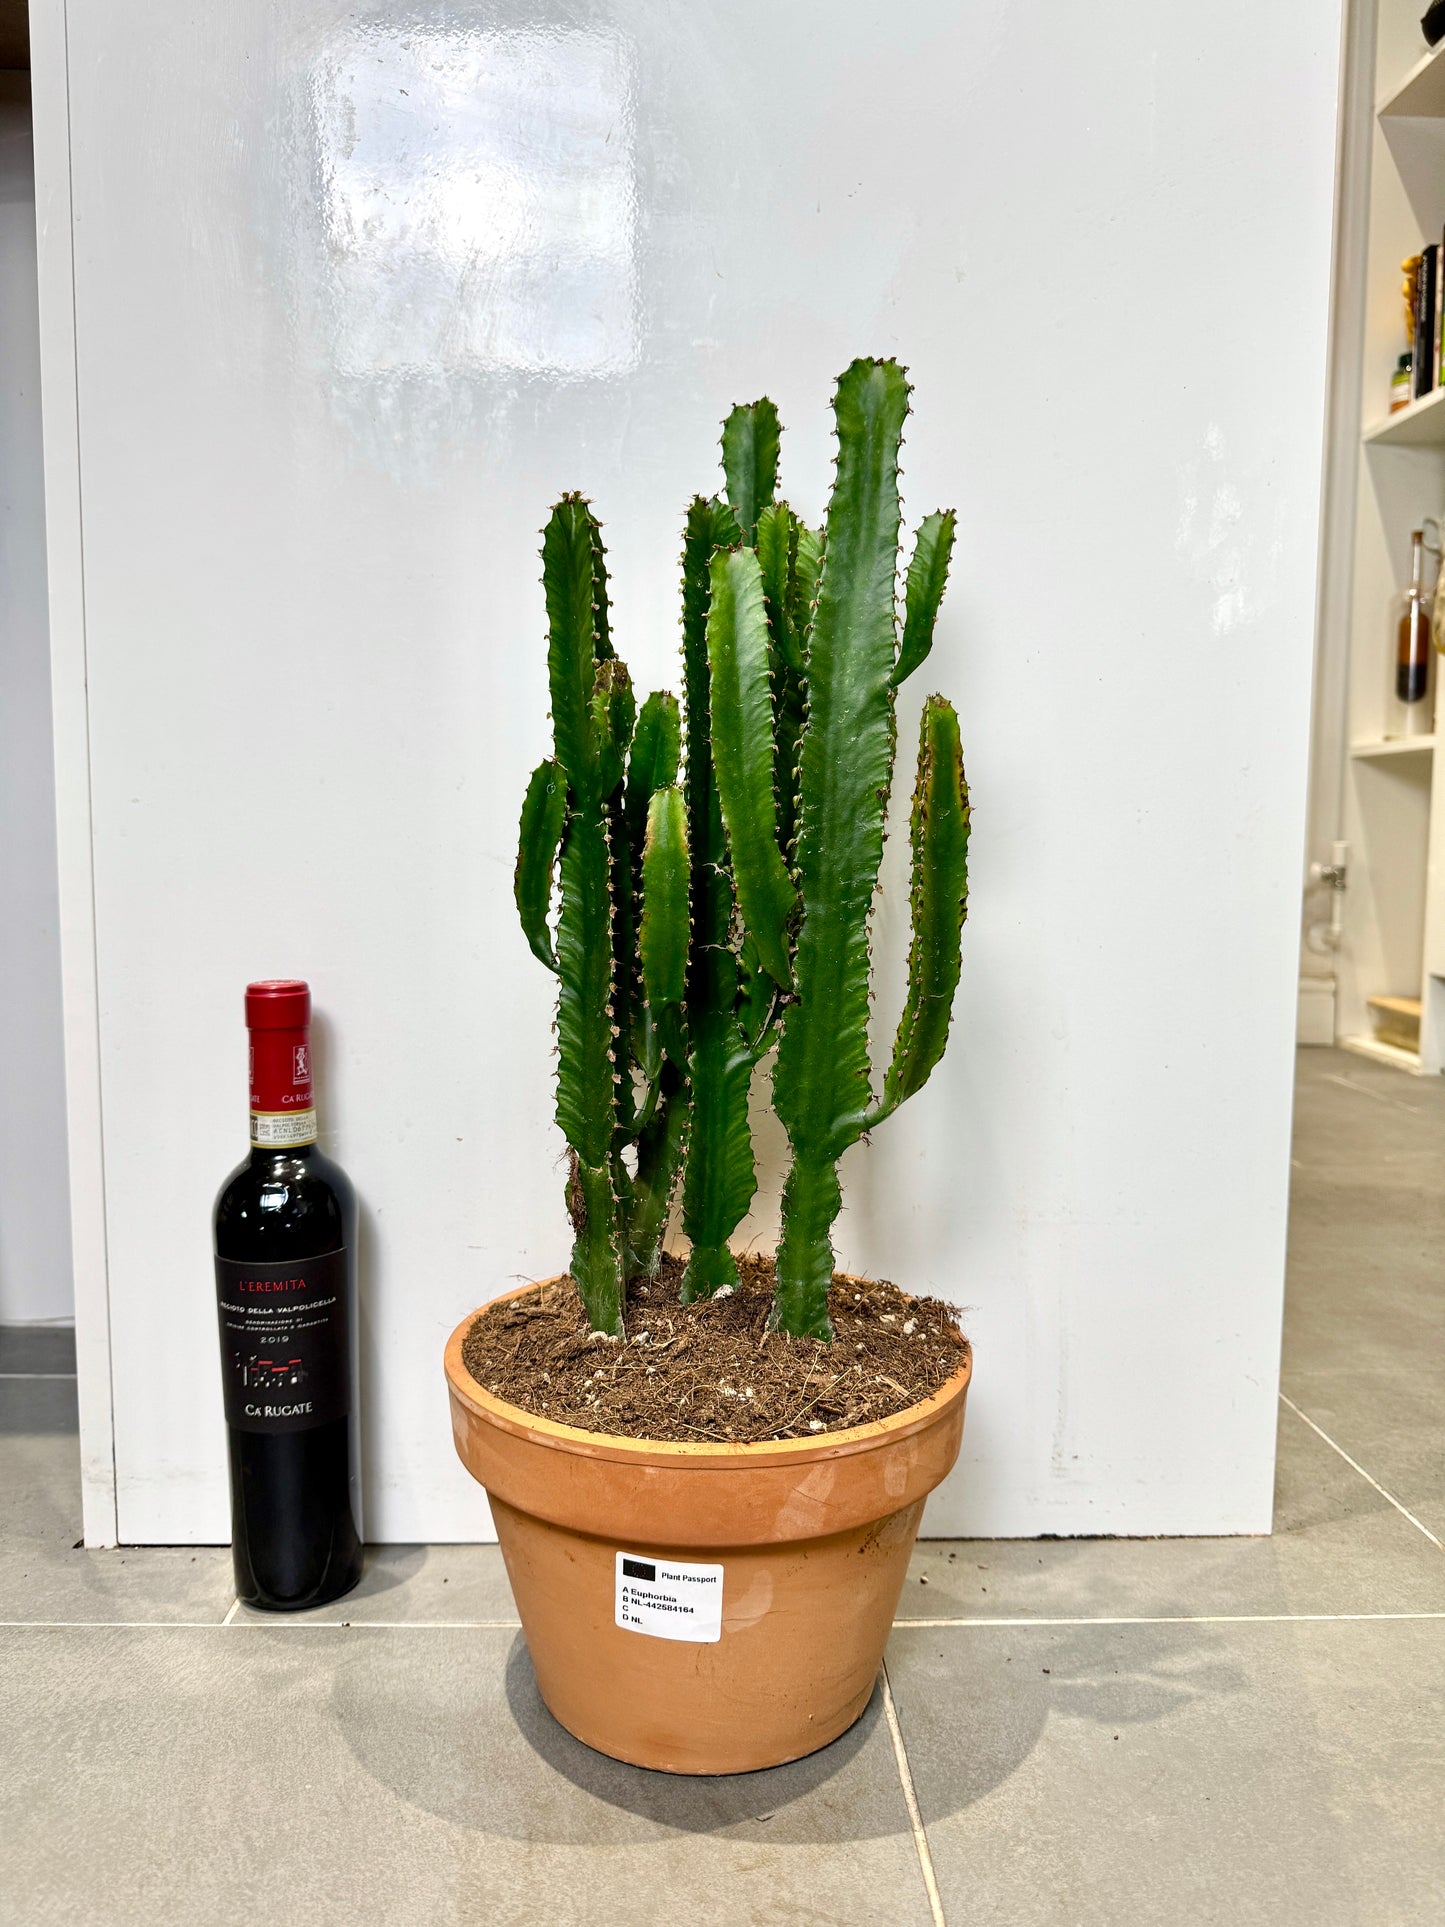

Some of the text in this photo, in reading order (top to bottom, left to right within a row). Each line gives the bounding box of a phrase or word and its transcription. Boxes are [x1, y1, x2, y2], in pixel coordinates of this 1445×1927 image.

[240, 1279, 306, 1292] L'EREMITA
[247, 1306, 274, 1314] DELLA
[276, 1296, 337, 1314] VALPOLICELLA
[260, 1335, 290, 1344] 2019
[265, 1402, 313, 1417] RUGATE
[661, 1572, 717, 1584] Plant Passport
[622, 1595, 629, 1603] B
[630, 1588, 677, 1603] Euphorbia
[622, 1613, 643, 1625] D NL
